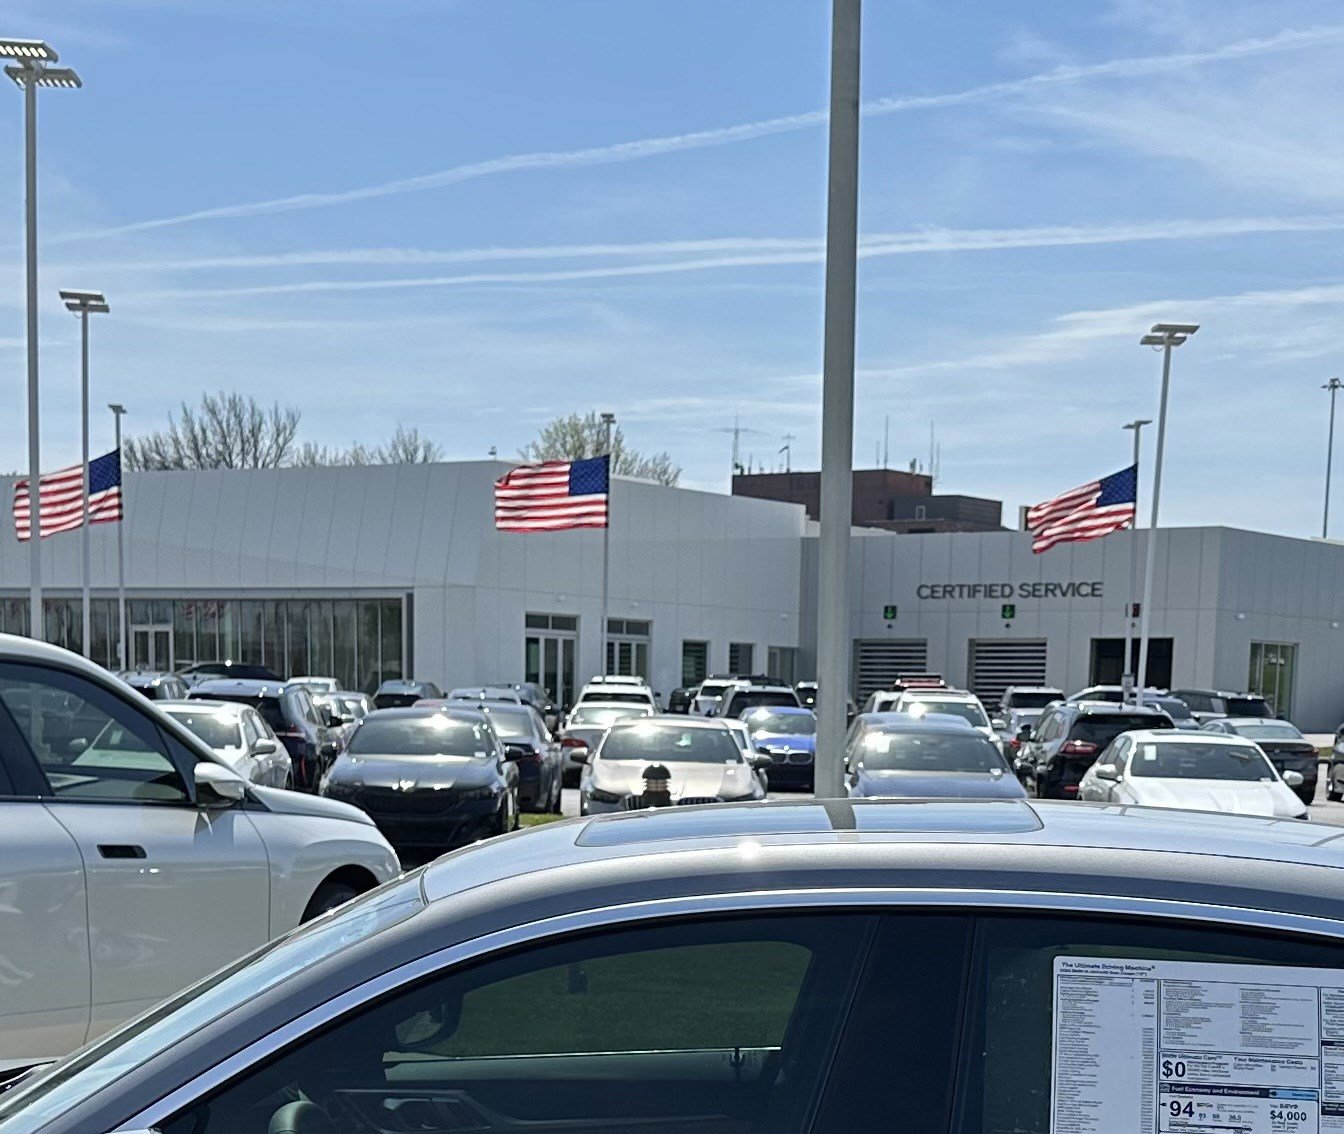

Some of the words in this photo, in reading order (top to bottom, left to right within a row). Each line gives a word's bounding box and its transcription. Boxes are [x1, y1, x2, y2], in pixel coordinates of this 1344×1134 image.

[916, 584, 1014, 600] CERTIFIED
[1018, 582, 1104, 598] SERVICE
[1101, 963, 1125, 971] Driving
[1162, 1060, 1186, 1079] $0
[1169, 1100, 1195, 1118] 94
